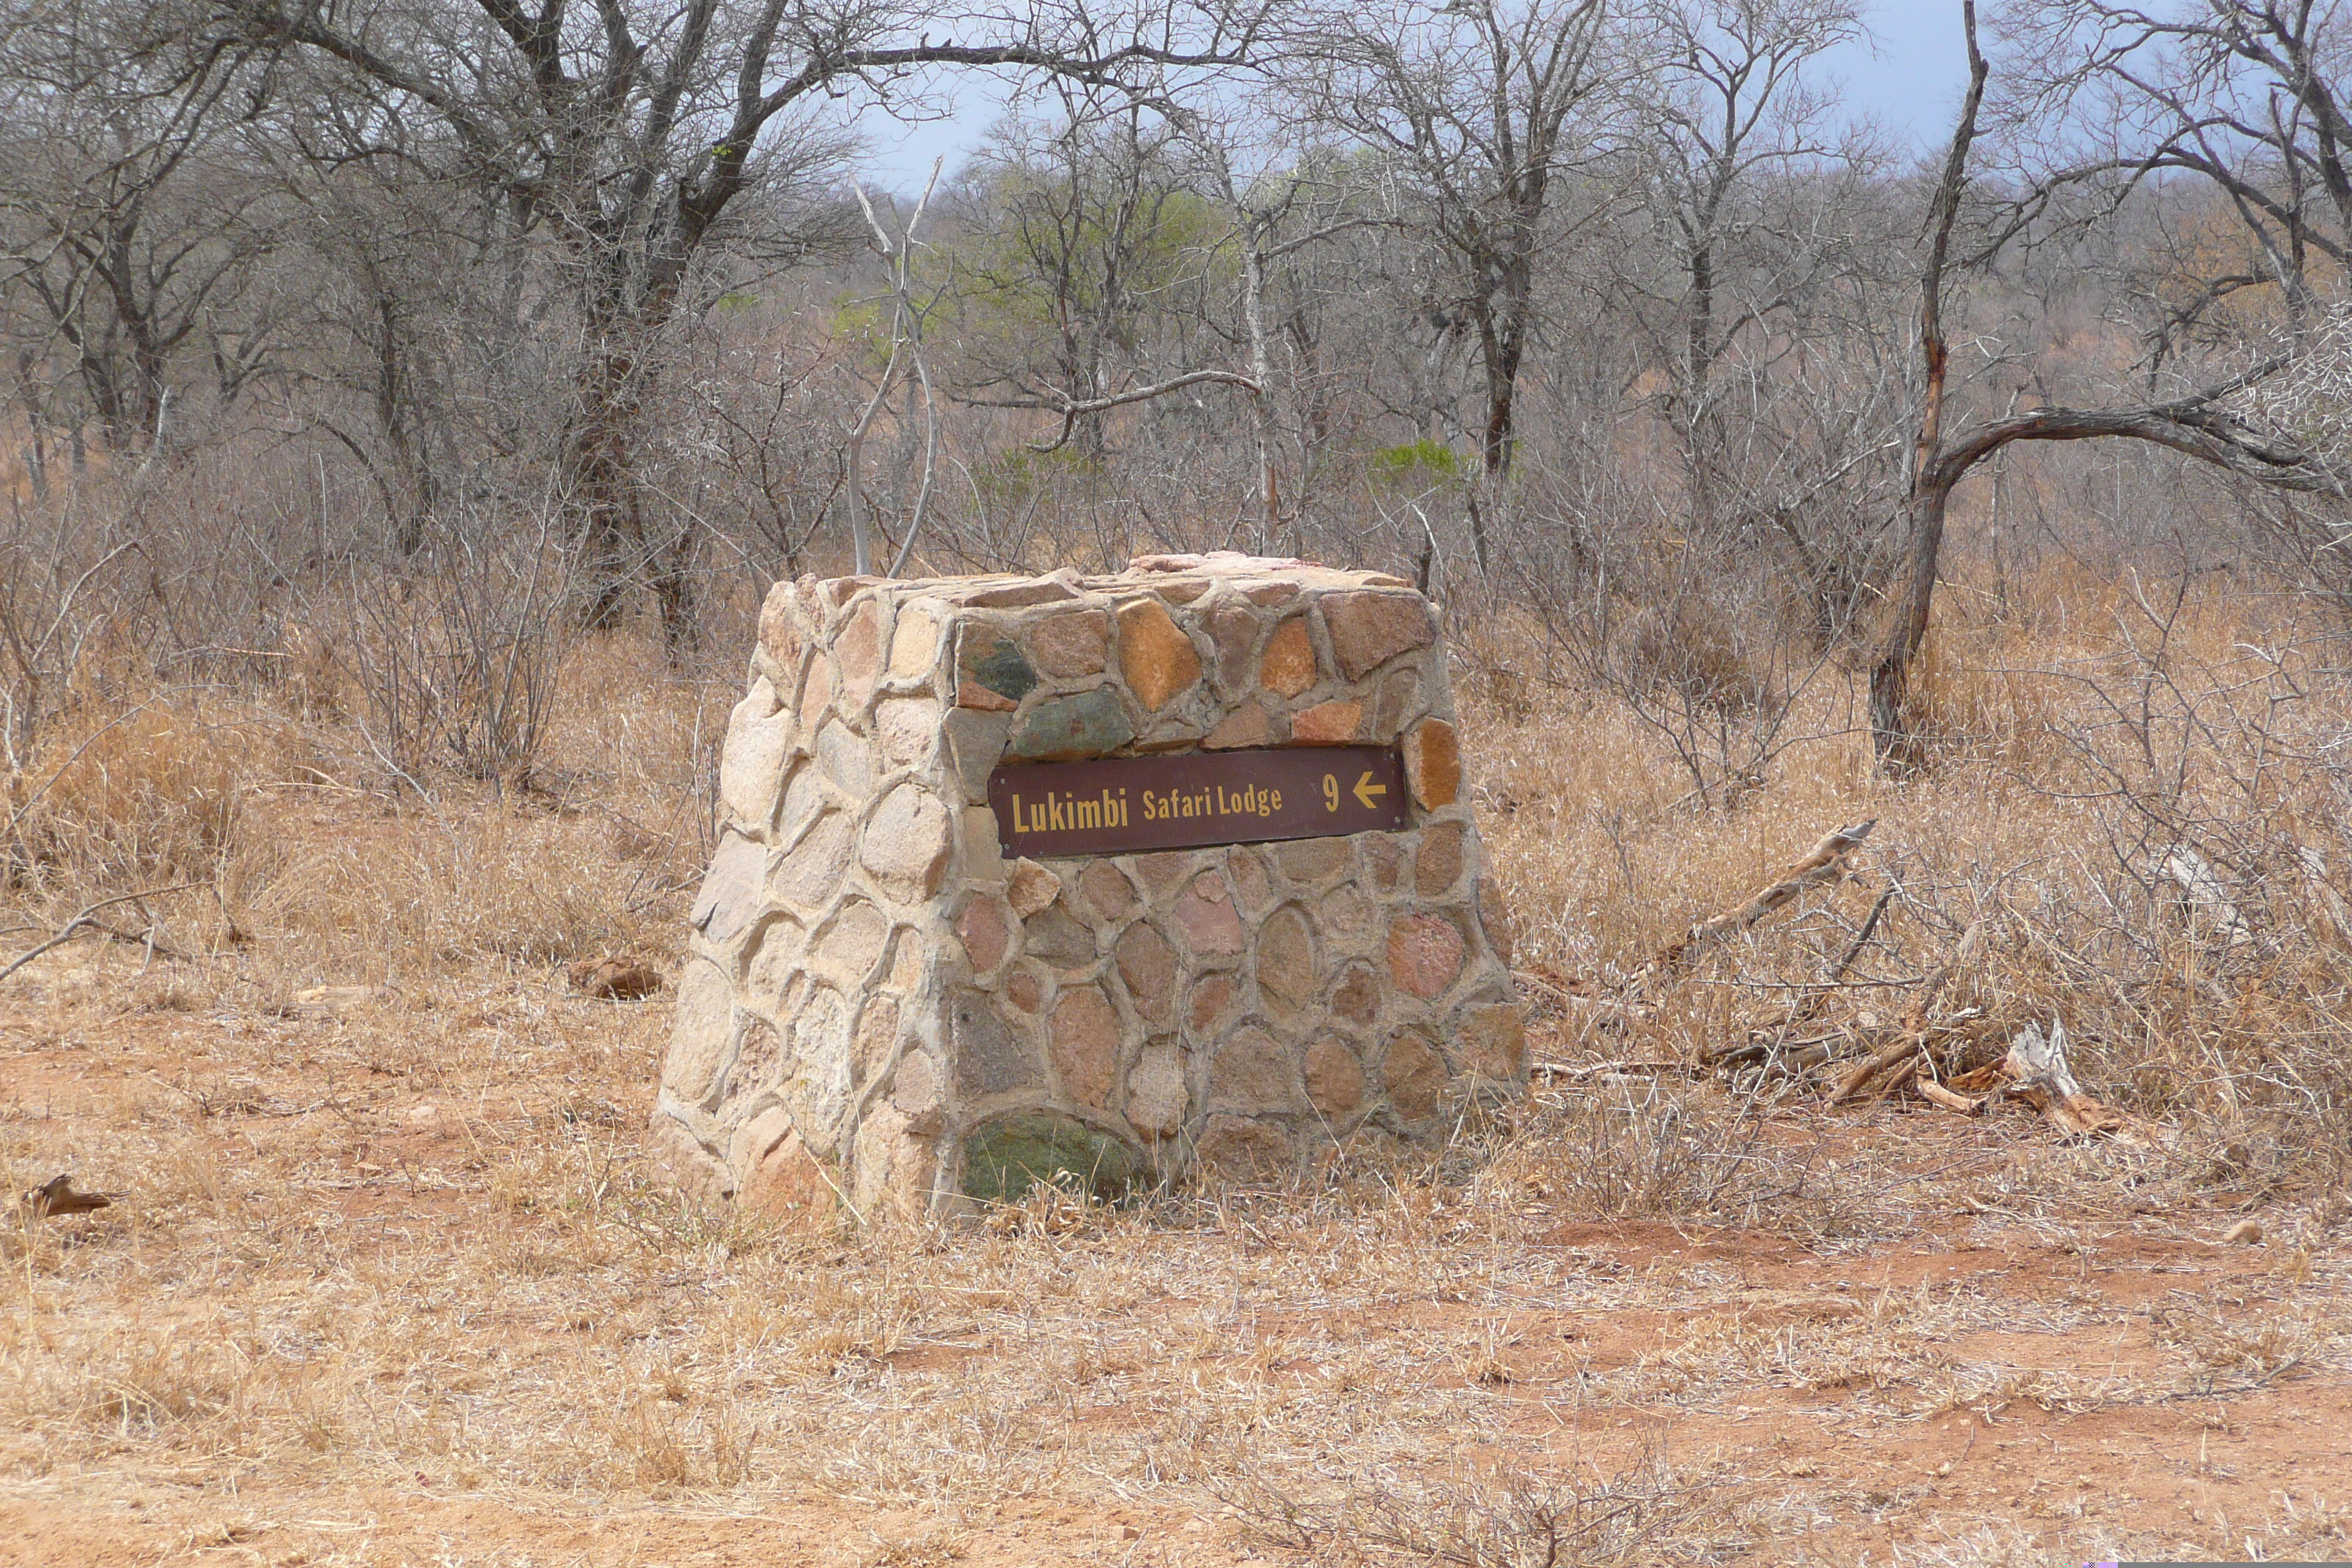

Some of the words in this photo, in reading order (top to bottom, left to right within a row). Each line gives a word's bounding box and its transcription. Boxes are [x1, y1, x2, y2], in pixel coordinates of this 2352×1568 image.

[1012, 788, 1128, 833] Lukimbi
[1142, 788, 1212, 820] Safari
[1217, 785, 1282, 817] Lodge
[1322, 774, 1340, 813] 9
